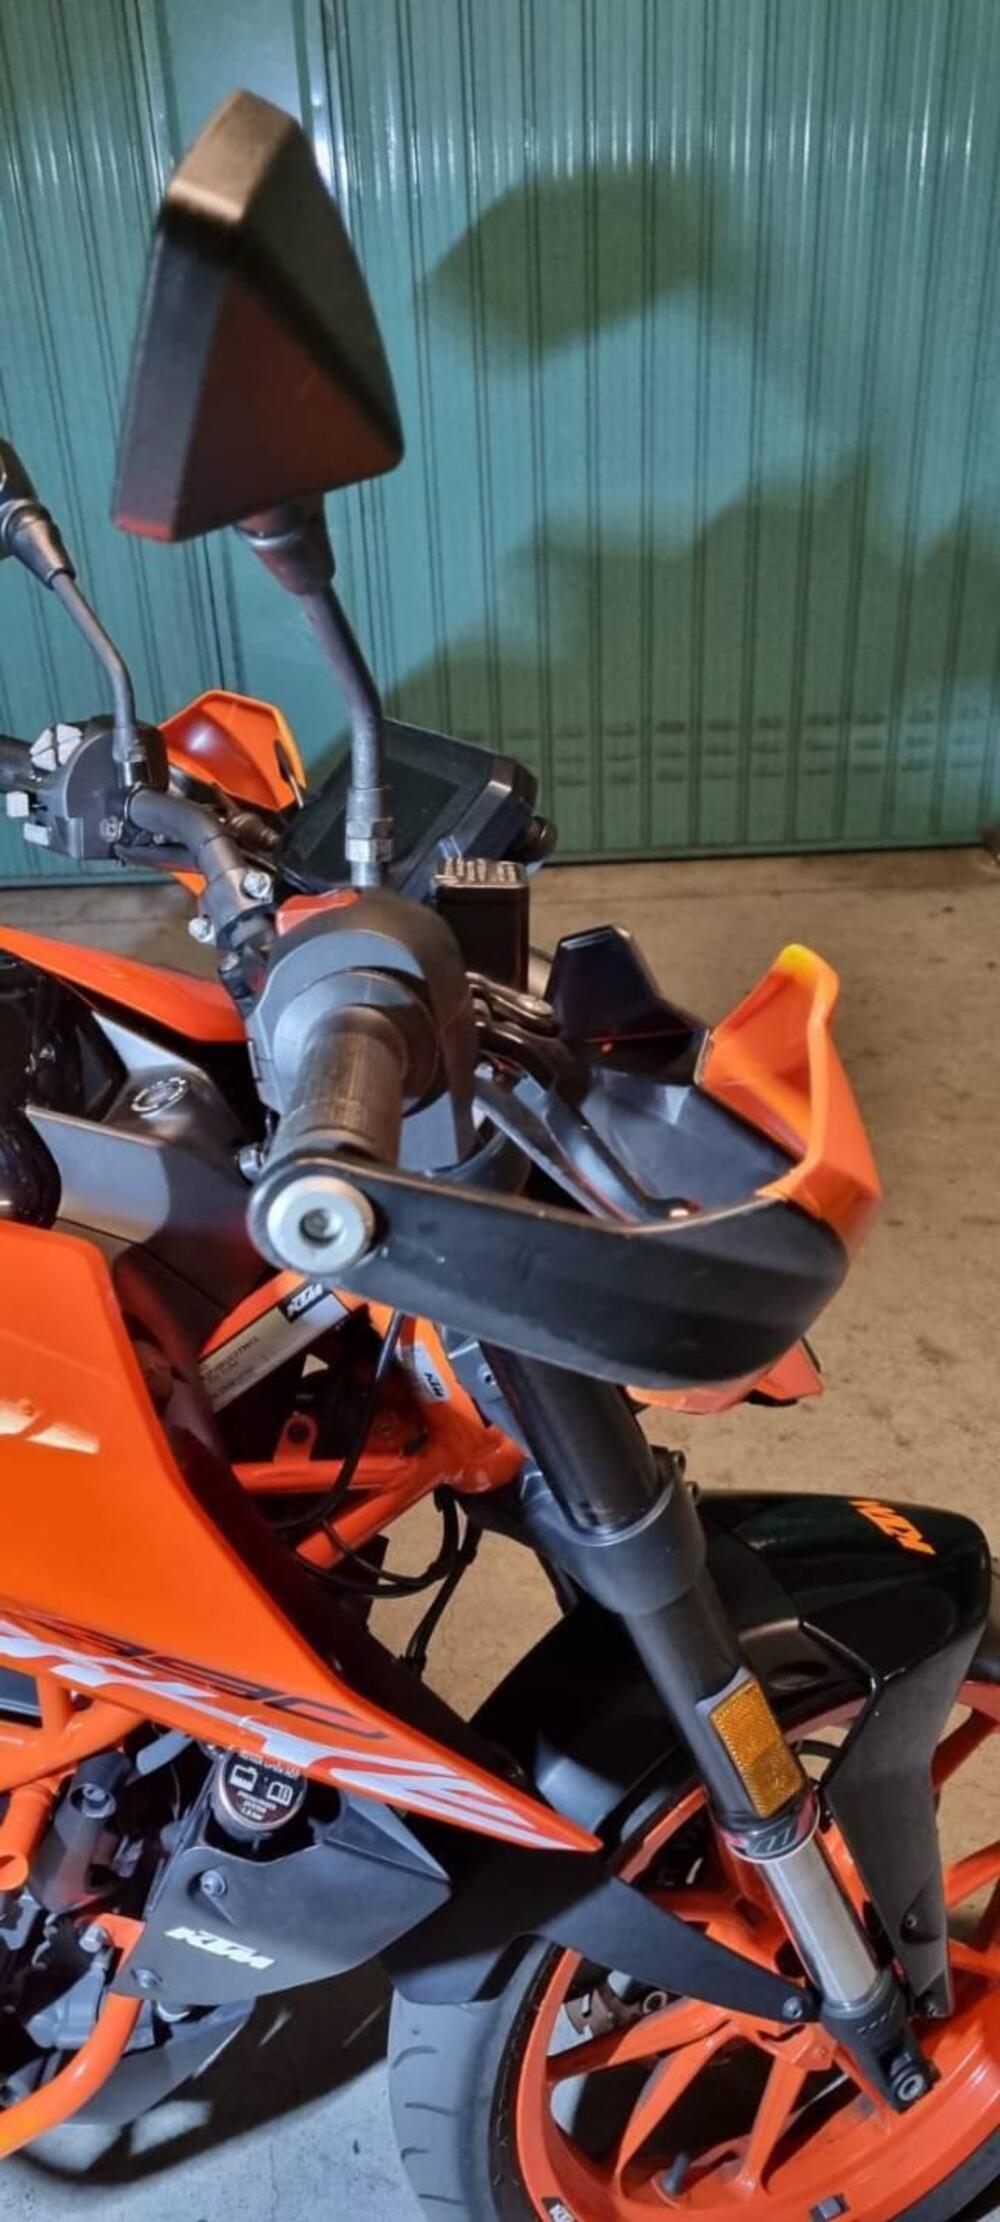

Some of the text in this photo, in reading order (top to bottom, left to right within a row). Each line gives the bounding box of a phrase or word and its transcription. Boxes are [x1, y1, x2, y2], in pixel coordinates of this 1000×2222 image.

[287, 1284, 323, 1317] KTM
[424, 1371, 444, 1398] KTM
[849, 1500, 936, 1555] KTM
[164, 1926, 275, 1970] KTM
